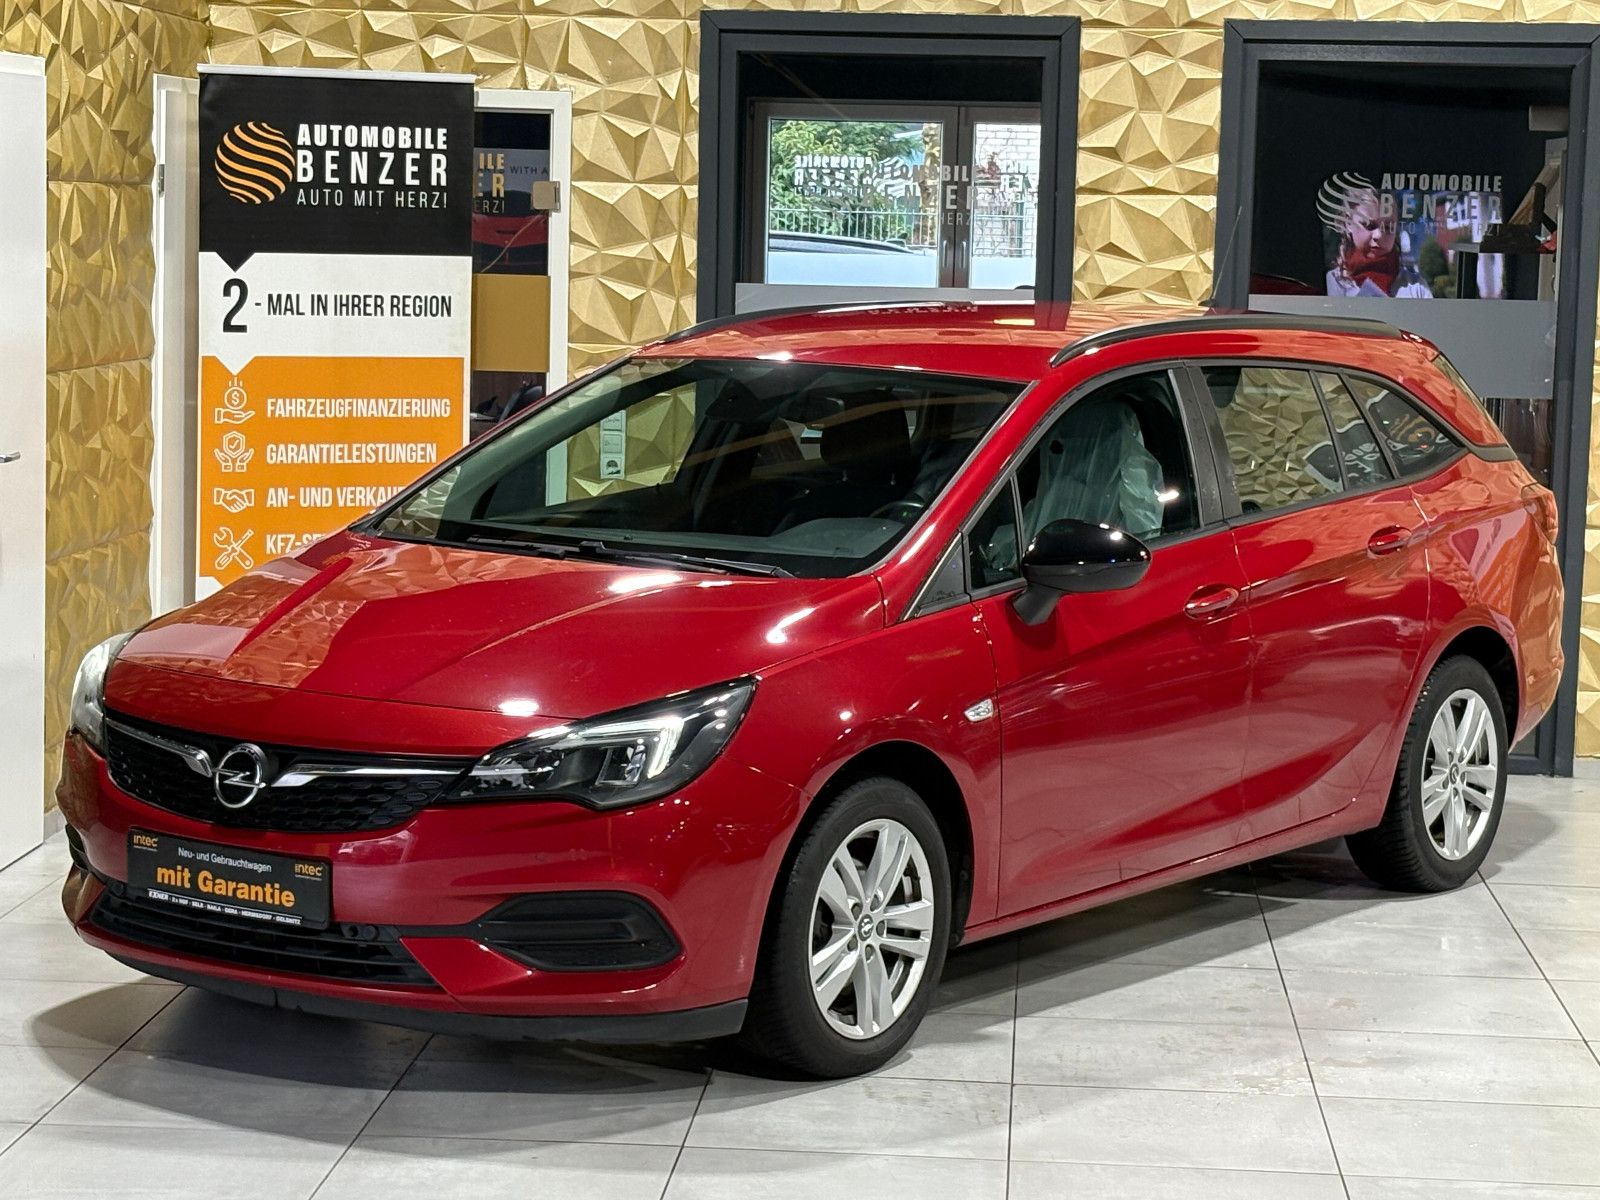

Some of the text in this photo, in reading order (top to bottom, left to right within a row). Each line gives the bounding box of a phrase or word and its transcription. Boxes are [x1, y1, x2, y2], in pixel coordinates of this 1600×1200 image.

[297, 123, 448, 150] AUTOMOBILE
[296, 150, 448, 187] BENZER
[510, 165, 538, 175] WITH
[1380, 172, 1502, 193] AUTOMOBILE
[296, 188, 448, 209] AUTO MIT HERZ!
[1379, 192, 1502, 224] BENZER
[267, 293, 305, 316] MAL
[310, 293, 328, 317] IN
[333, 294, 385, 317] IHRER
[389, 294, 452, 318] REGION
[266, 397, 451, 418] FAHRZEUGFINANZIERUNG
[266, 443, 437, 464] GARANTIELEISTUNGEN
[266, 486, 405, 508] AN- UND VERKAU
[177, 846, 272, 873] Neu- und Gebrauchtwagen
[156, 864, 296, 908] mit Garantie
